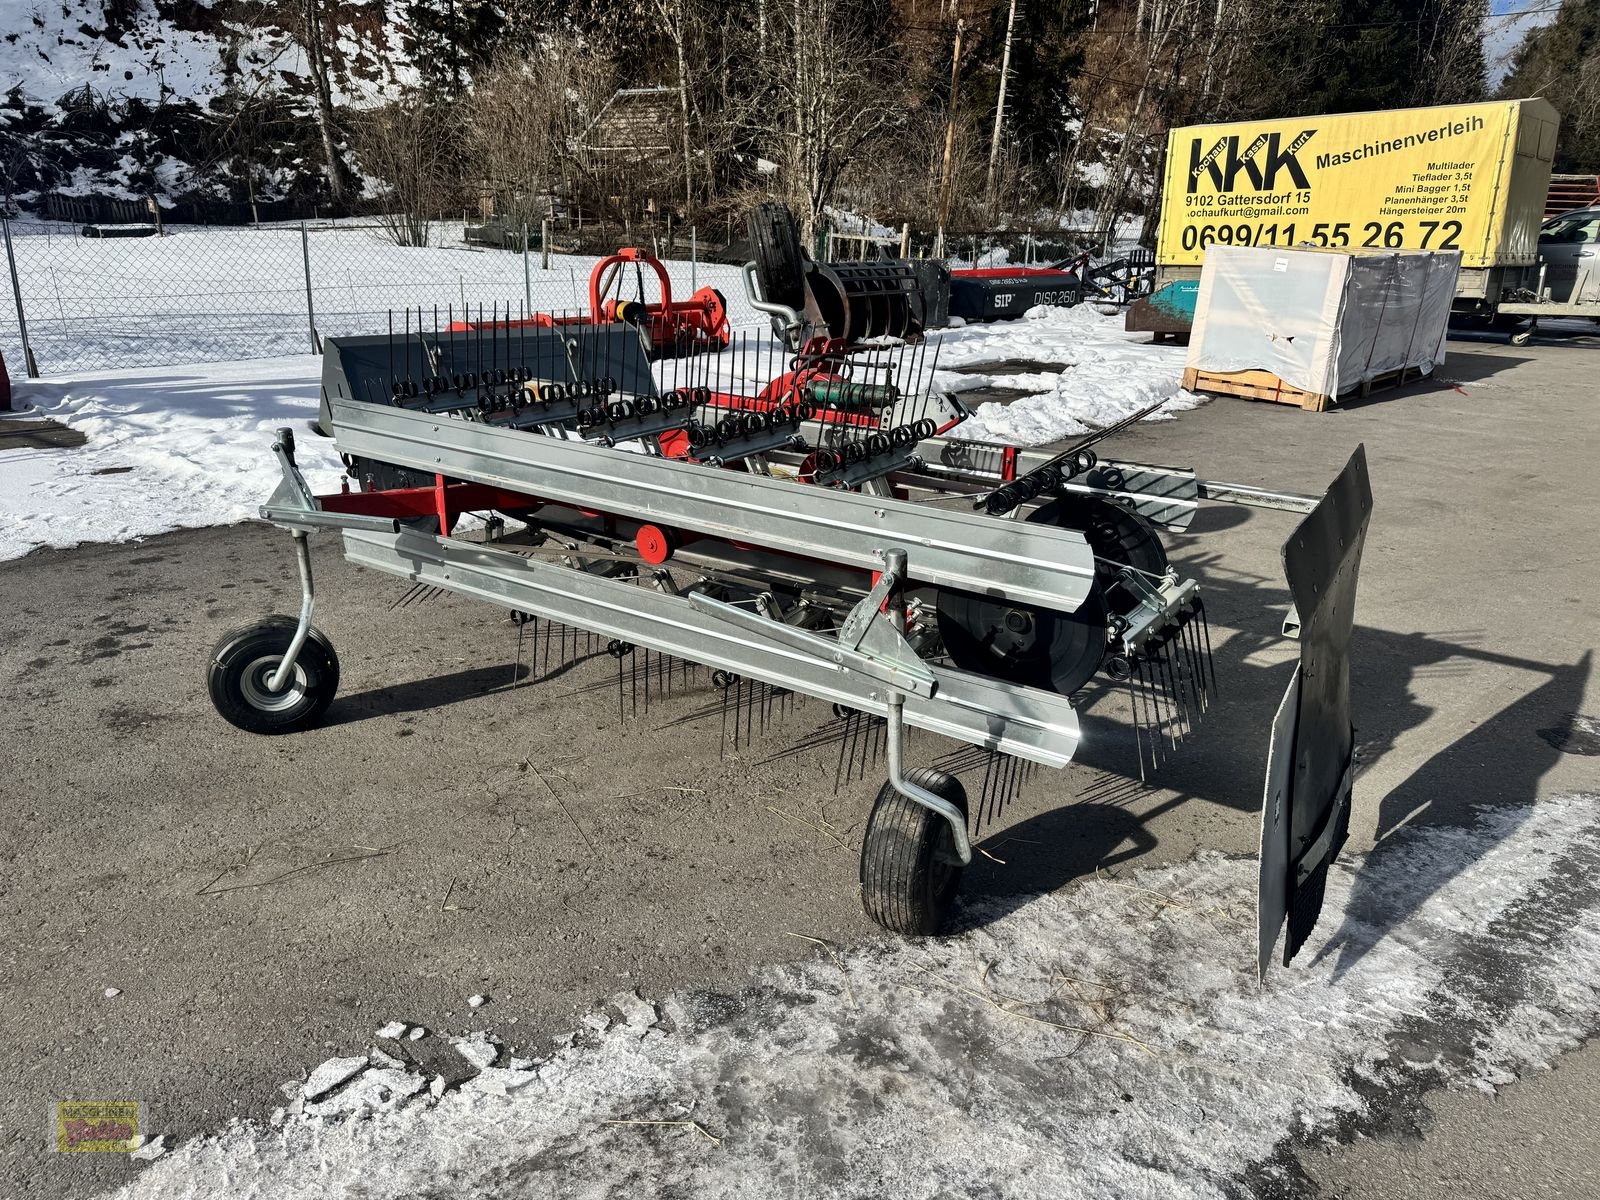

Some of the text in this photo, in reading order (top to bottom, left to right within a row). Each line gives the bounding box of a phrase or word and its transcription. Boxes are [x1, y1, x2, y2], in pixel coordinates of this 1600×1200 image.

[1239, 136, 1266, 164] Kassl
[1287, 132, 1310, 156] Kurt
[1316, 116, 1484, 169] Maschinenverleih
[1187, 130, 1318, 193] KKK
[1191, 138, 1227, 178] Kochauf
[1427, 162, 1475, 171] Multilader
[1412, 172, 1473, 182] Tieflader 3,5t
[1395, 184, 1471, 195] Mini Bagger 1,5t
[1186, 192, 1311, 207] 9102 Gattersdorf 15
[1384, 194, 1468, 205] Planenhänger 3,5t
[1187, 206, 1309, 218] ochaufkurt@gmail.com
[1379, 206, 1466, 216] Hängersteiger 20m
[1182, 220, 1463, 250] 0699/11 55 26 72
[994, 290, 1076, 308] SIP DISC 260
